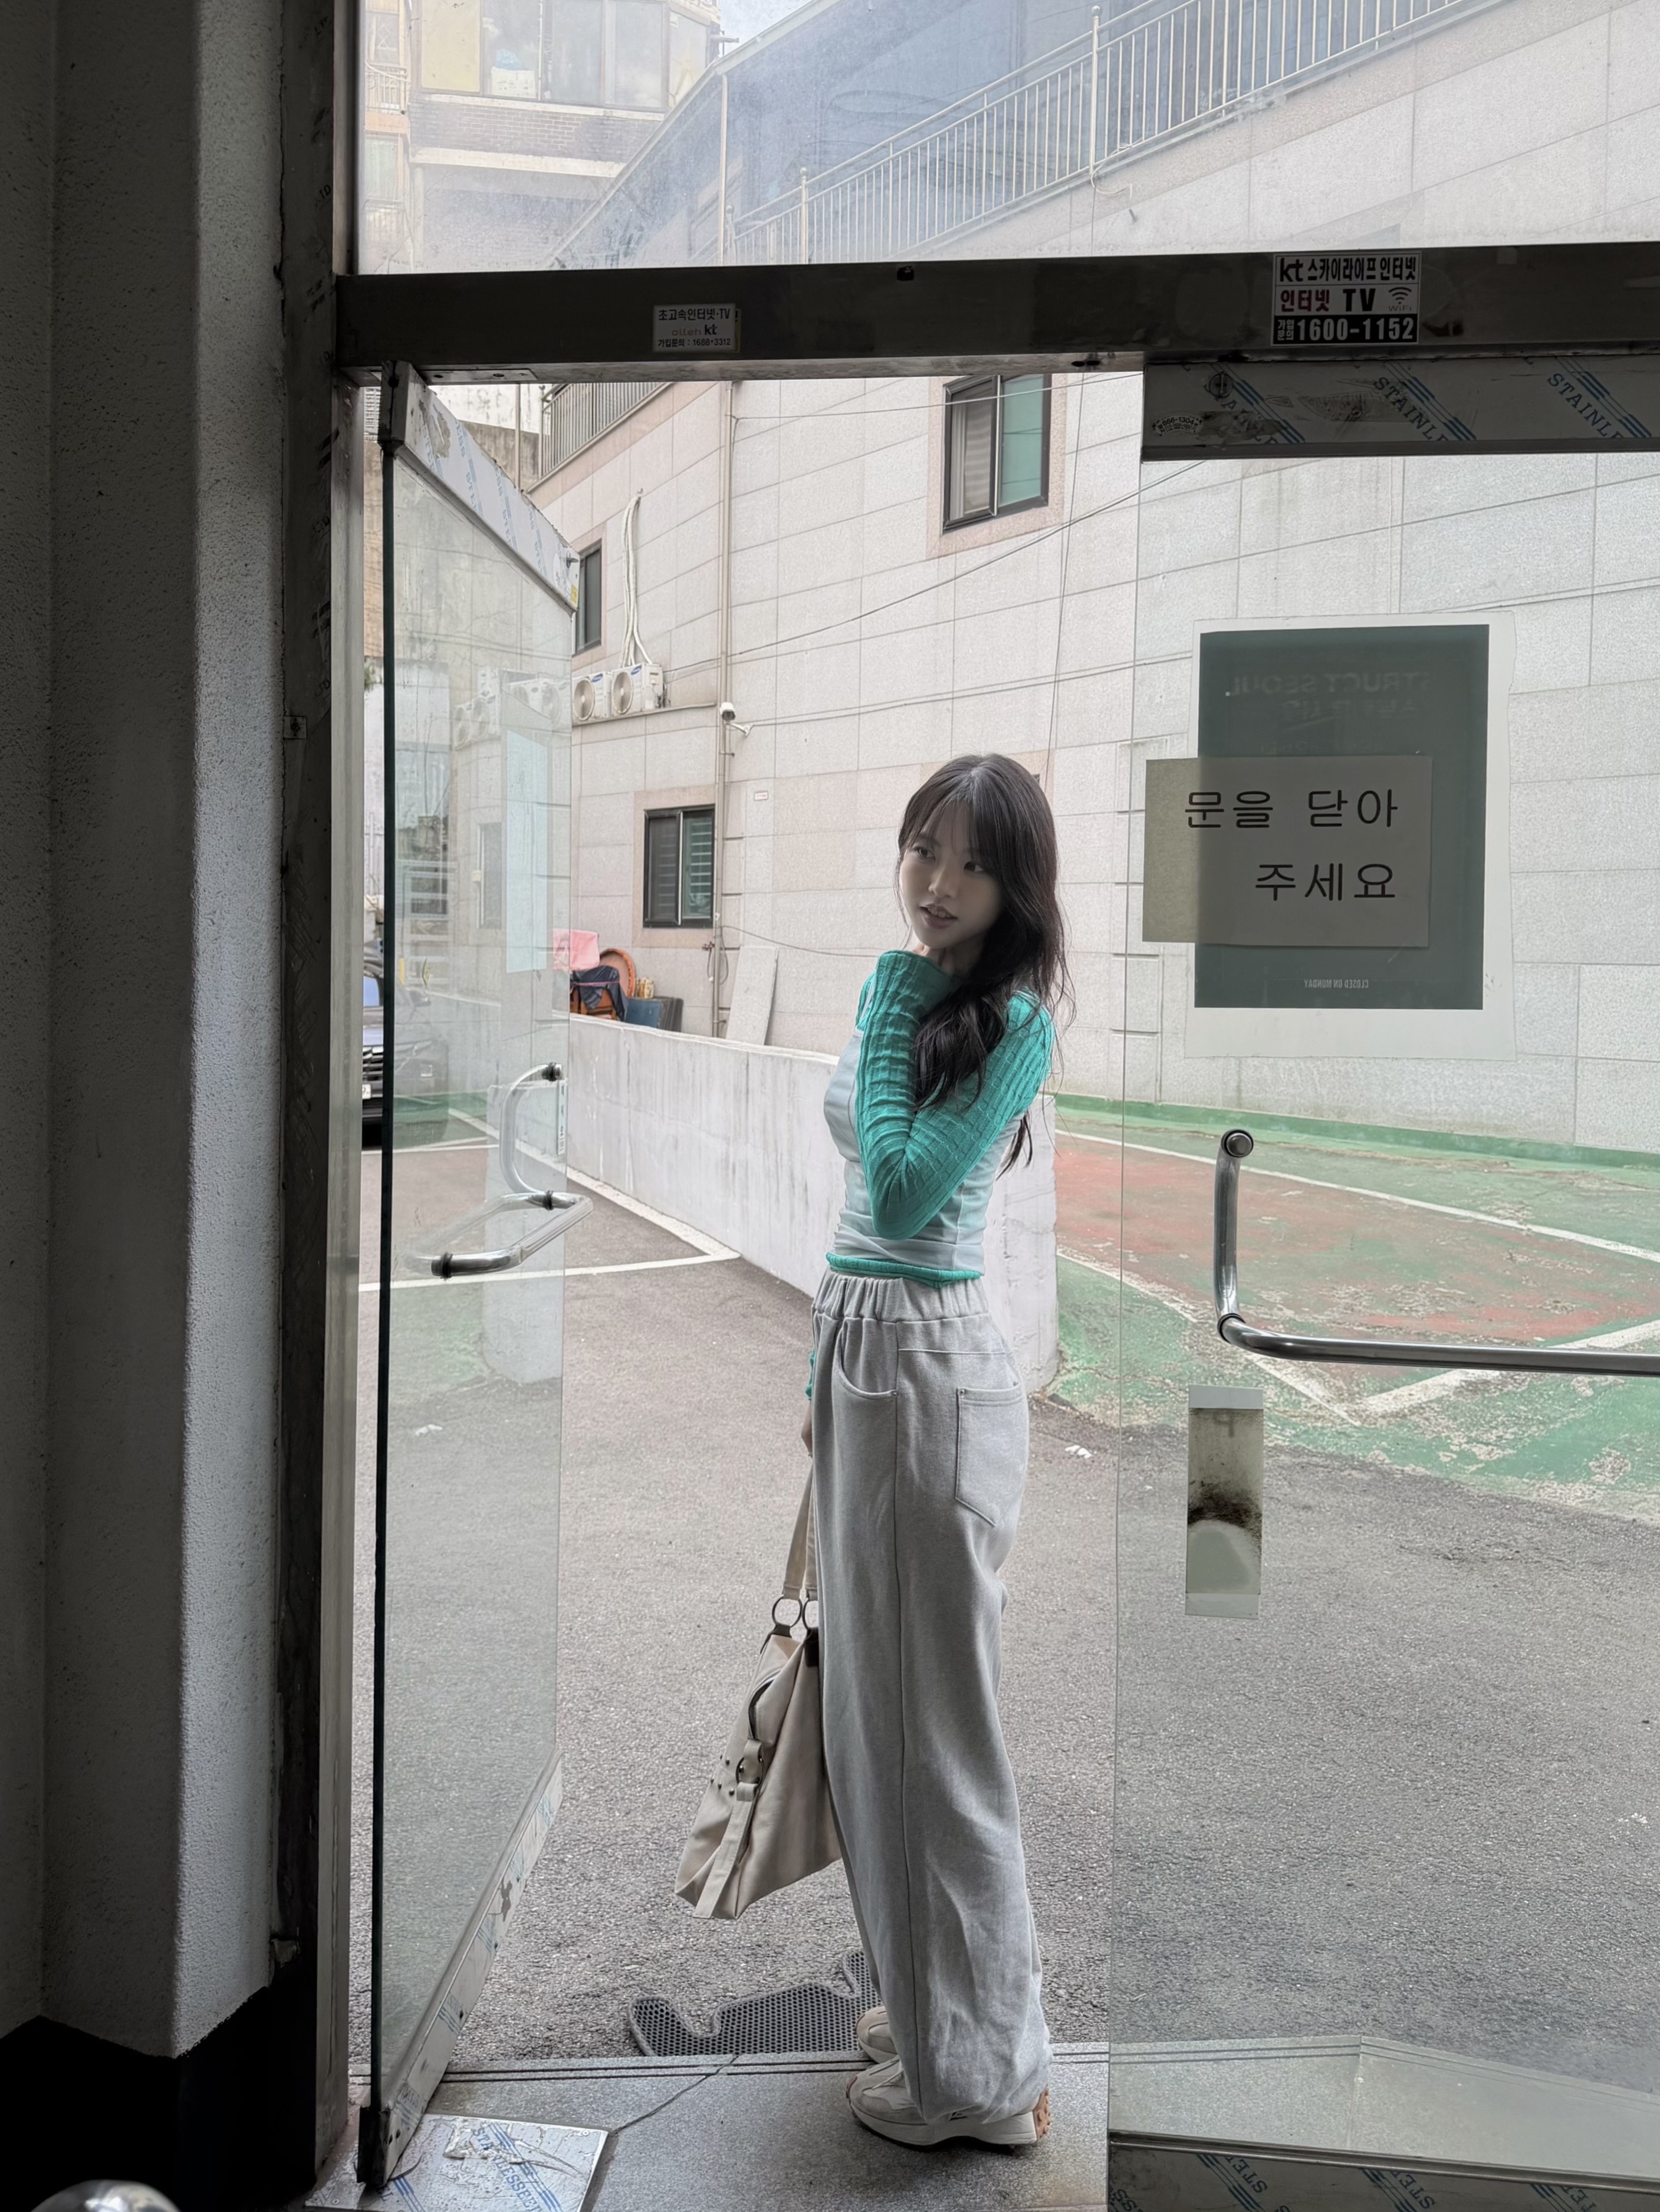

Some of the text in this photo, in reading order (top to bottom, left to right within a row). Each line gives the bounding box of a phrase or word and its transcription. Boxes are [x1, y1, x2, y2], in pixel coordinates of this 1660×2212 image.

[1280, 257, 1416, 282] kt 스카이라이프 인터넷
[1280, 289, 1330, 312] 인터넷
[1343, 288, 1376, 312] TV
[704, 324, 718, 336] kt
[1277, 319, 1294, 330] 가입
[1277, 330, 1294, 341] 문의
[1297, 317, 1414, 341] 1600-1152
[1185, 789, 1398, 828] 문을 닫아
[1255, 863, 1396, 901] 주세요
